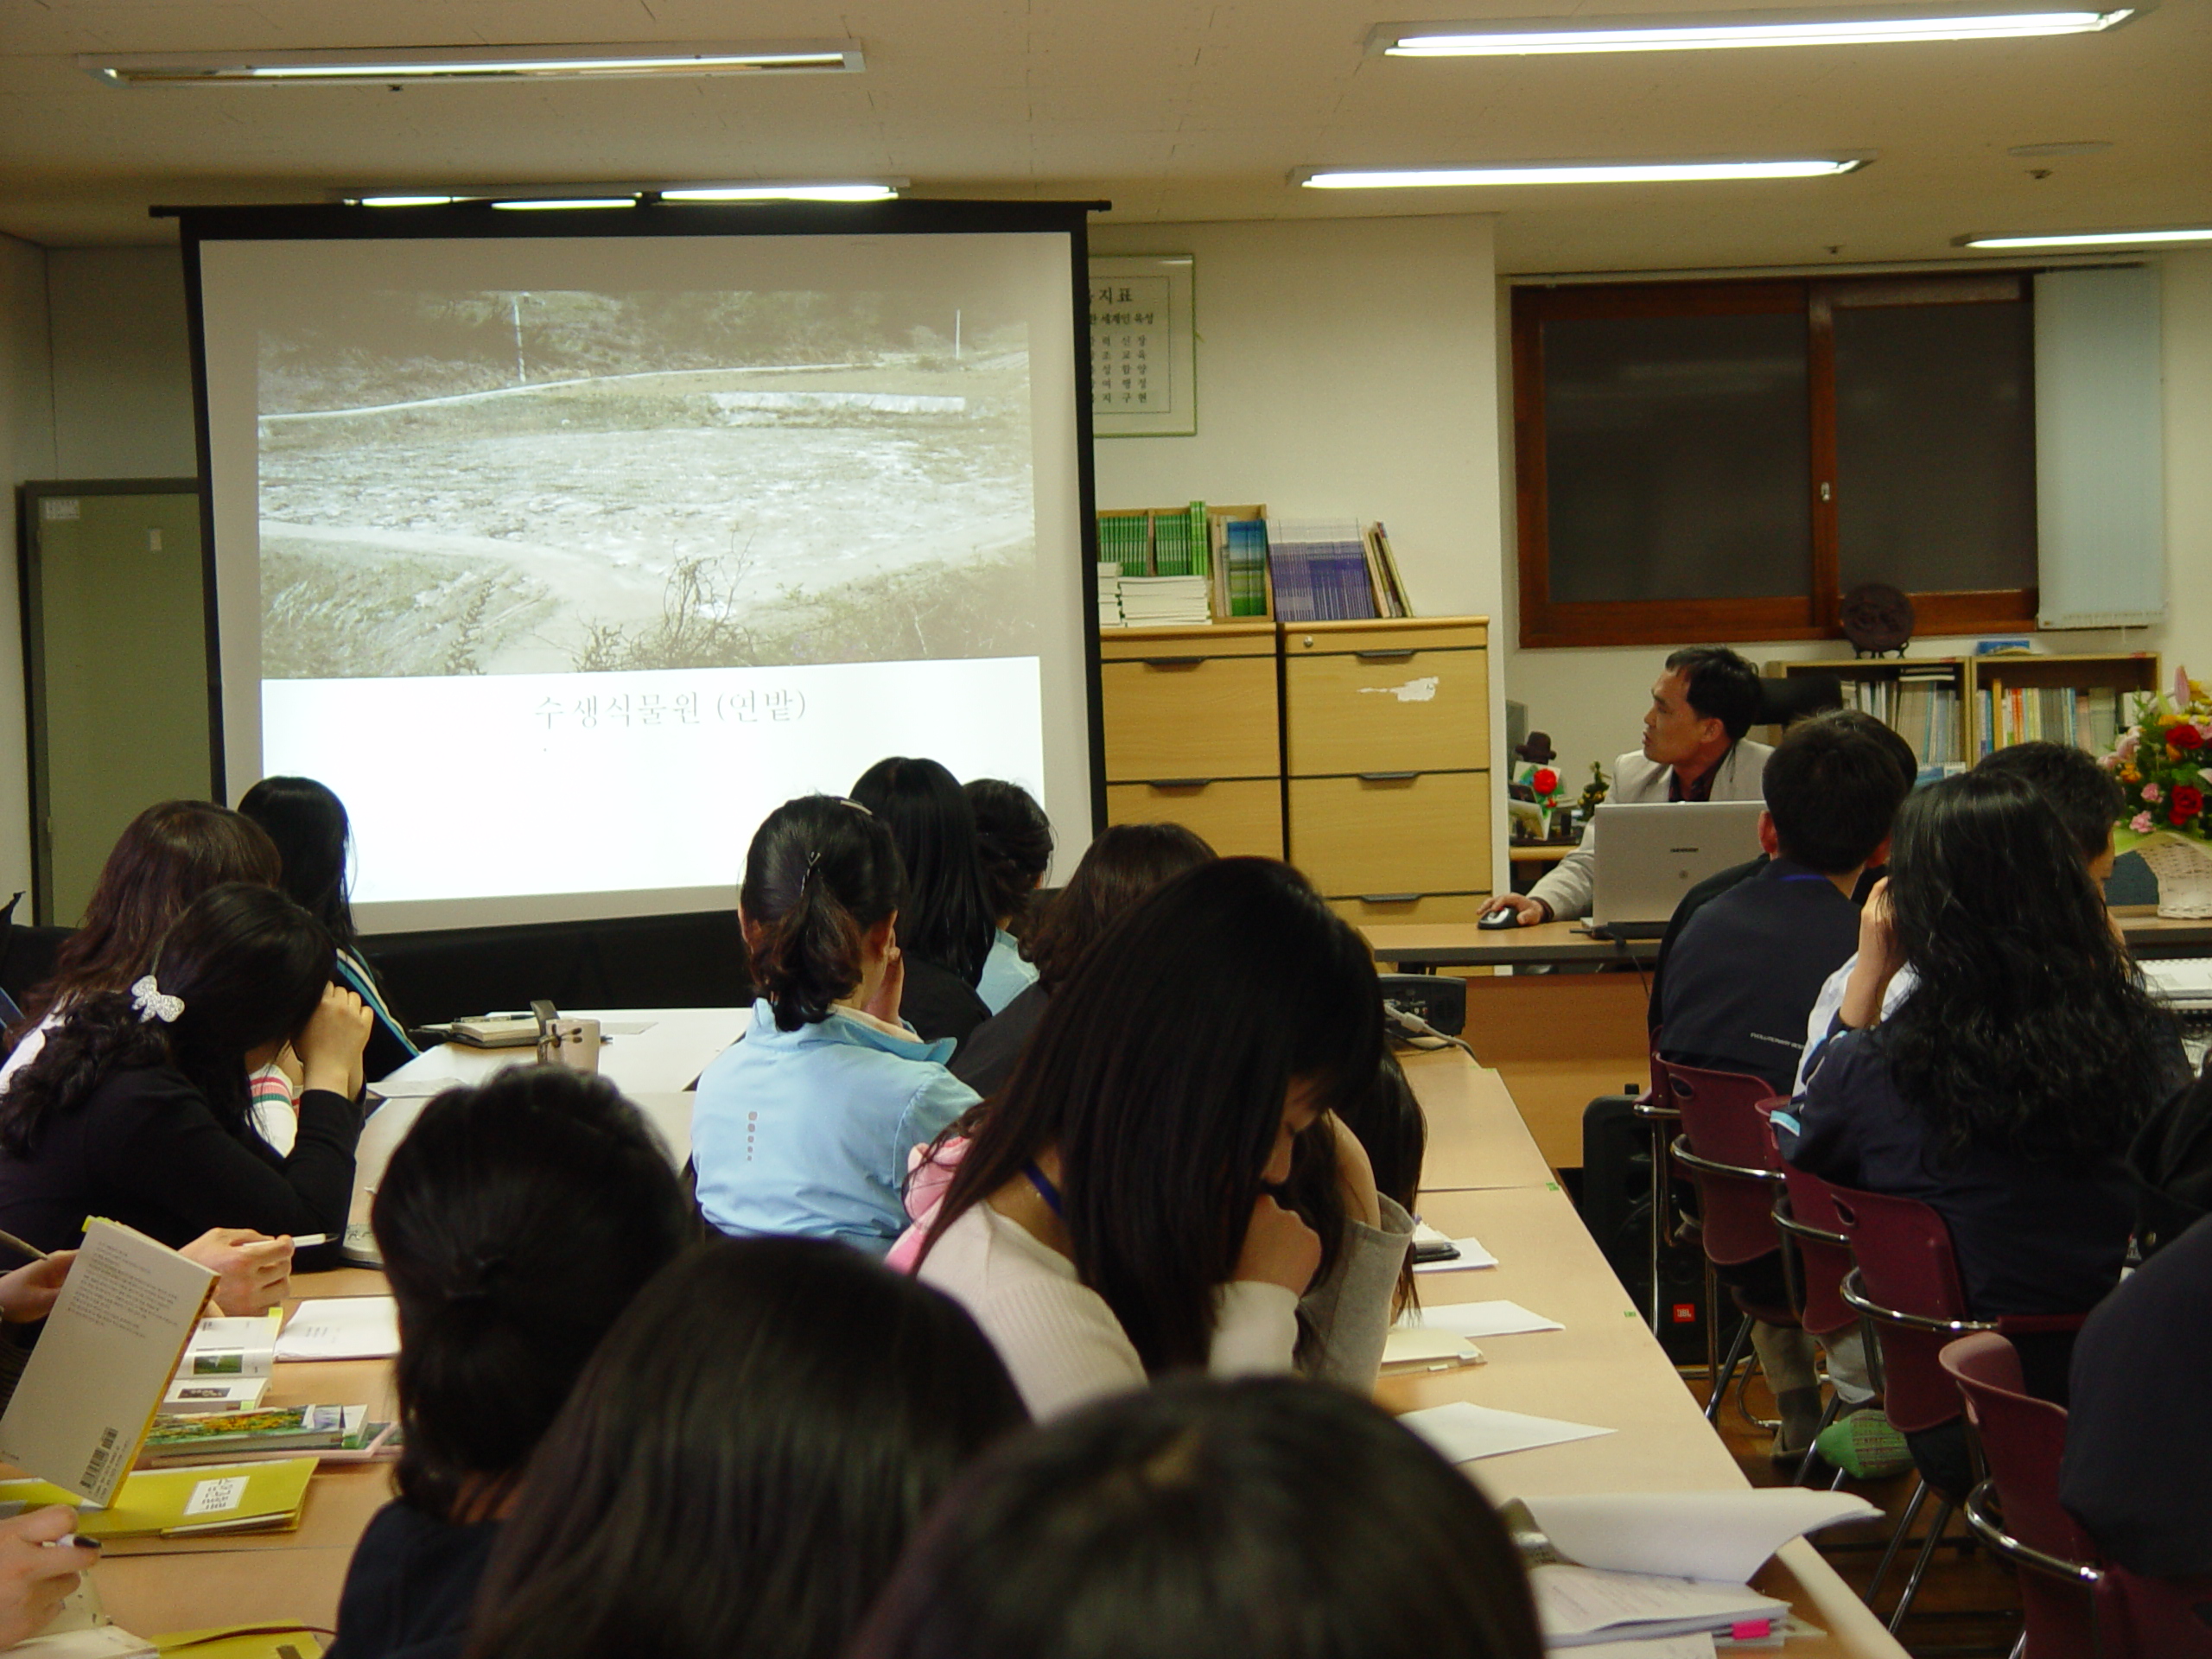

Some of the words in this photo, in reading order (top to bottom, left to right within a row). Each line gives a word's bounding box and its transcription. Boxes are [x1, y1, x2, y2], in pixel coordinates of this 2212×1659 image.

[1090, 287, 1134, 305] 지표
[535, 691, 701, 730] 수생식물원
[1676, 1308, 1692, 1319] JBL
